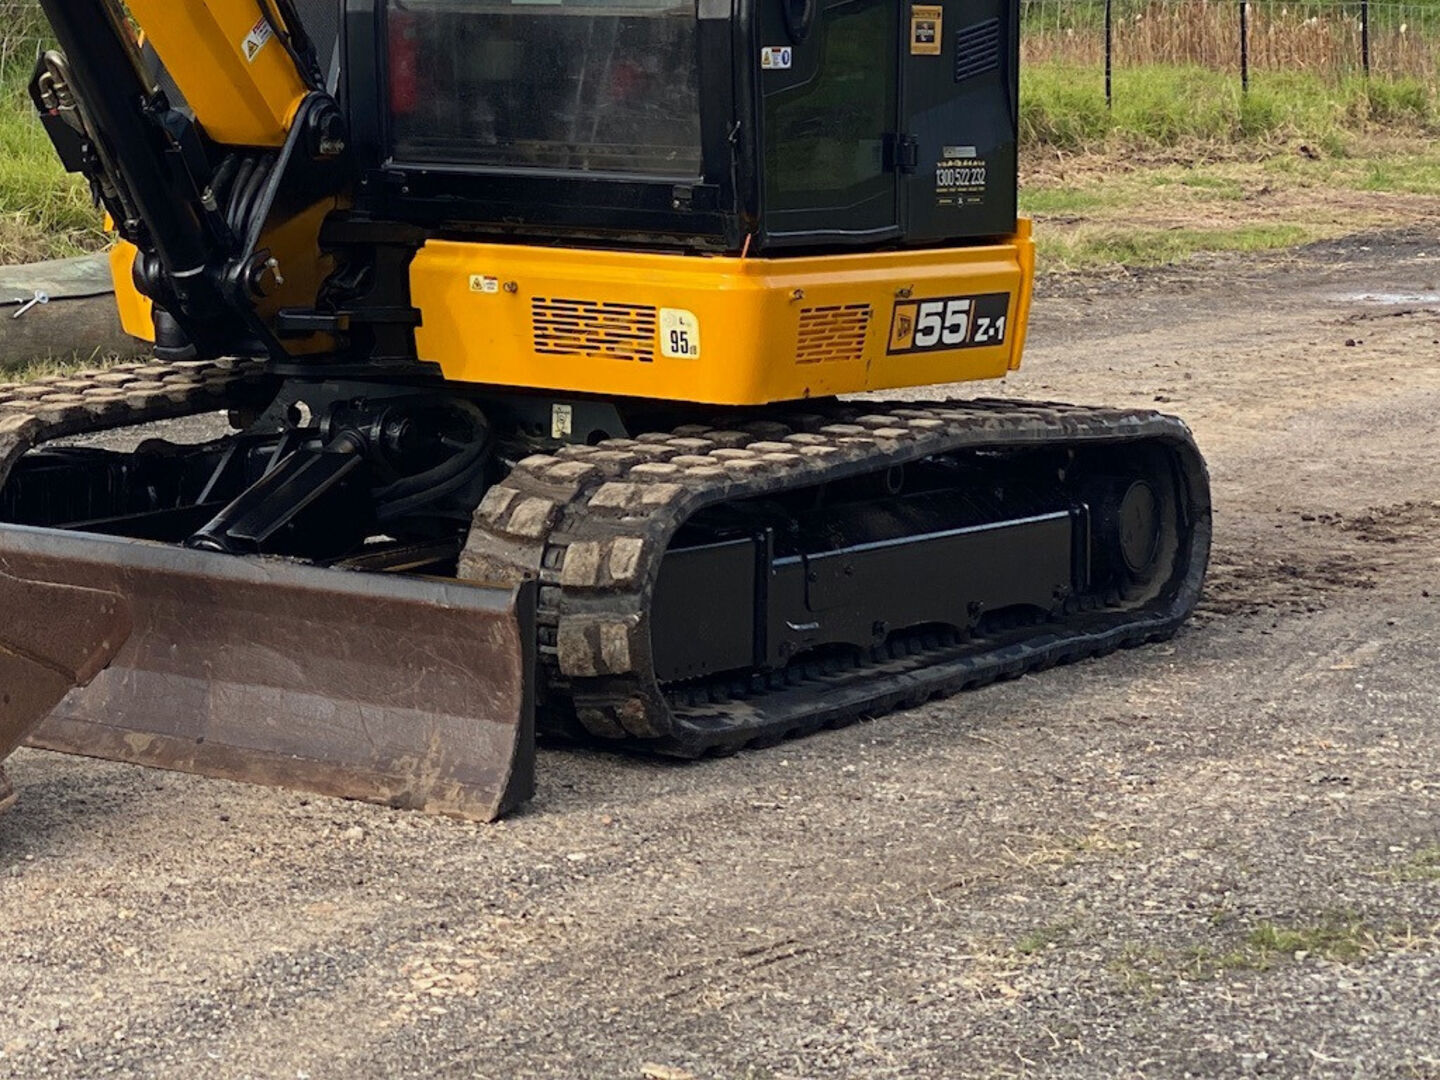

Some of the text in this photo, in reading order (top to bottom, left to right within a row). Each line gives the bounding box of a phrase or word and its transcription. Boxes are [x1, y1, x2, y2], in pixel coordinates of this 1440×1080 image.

[936, 168, 986, 186] 1300 522 232
[915, 299, 971, 347] 55
[670, 329, 689, 354] 95
